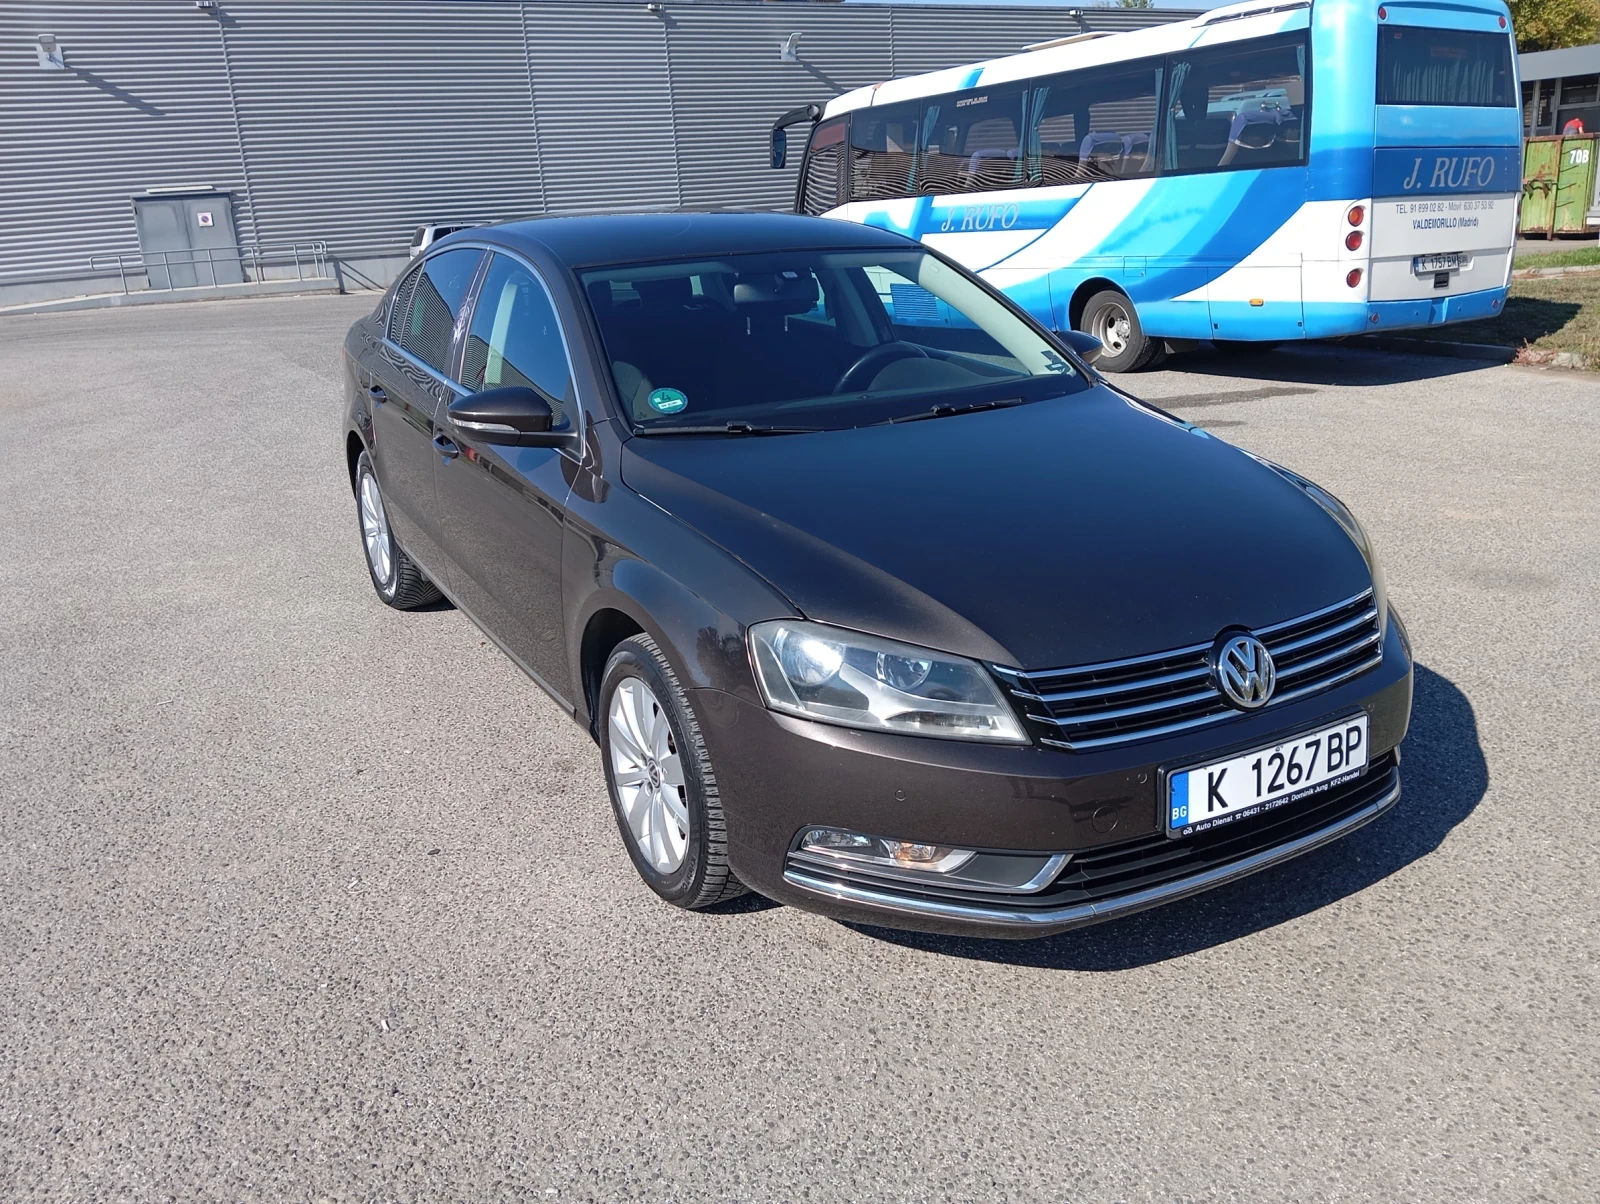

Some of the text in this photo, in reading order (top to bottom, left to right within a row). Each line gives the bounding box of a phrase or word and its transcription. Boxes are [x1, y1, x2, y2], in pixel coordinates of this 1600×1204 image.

[1403, 156, 1495, 190] J. RUFO
[941, 203, 1020, 232] J. RUFO
[1410, 203, 1417, 214] 91
[1412, 216, 1479, 230] VALDEMORILLO (Madrid)
[1421, 258, 1427, 271] K
[1430, 256, 1446, 270] 1757
[1207, 725, 1363, 812] K 1267 BP
[1195, 822, 1211, 832] Auto
[1212, 815, 1234, 827] Dienst
[1242, 806, 1261, 818] 06431
[1291, 788, 1314, 802] Dominik
[1314, 783, 1329, 793] Jung
[1330, 769, 1360, 787] KFZ-Handel
[1172, 805, 1188, 820] BG
